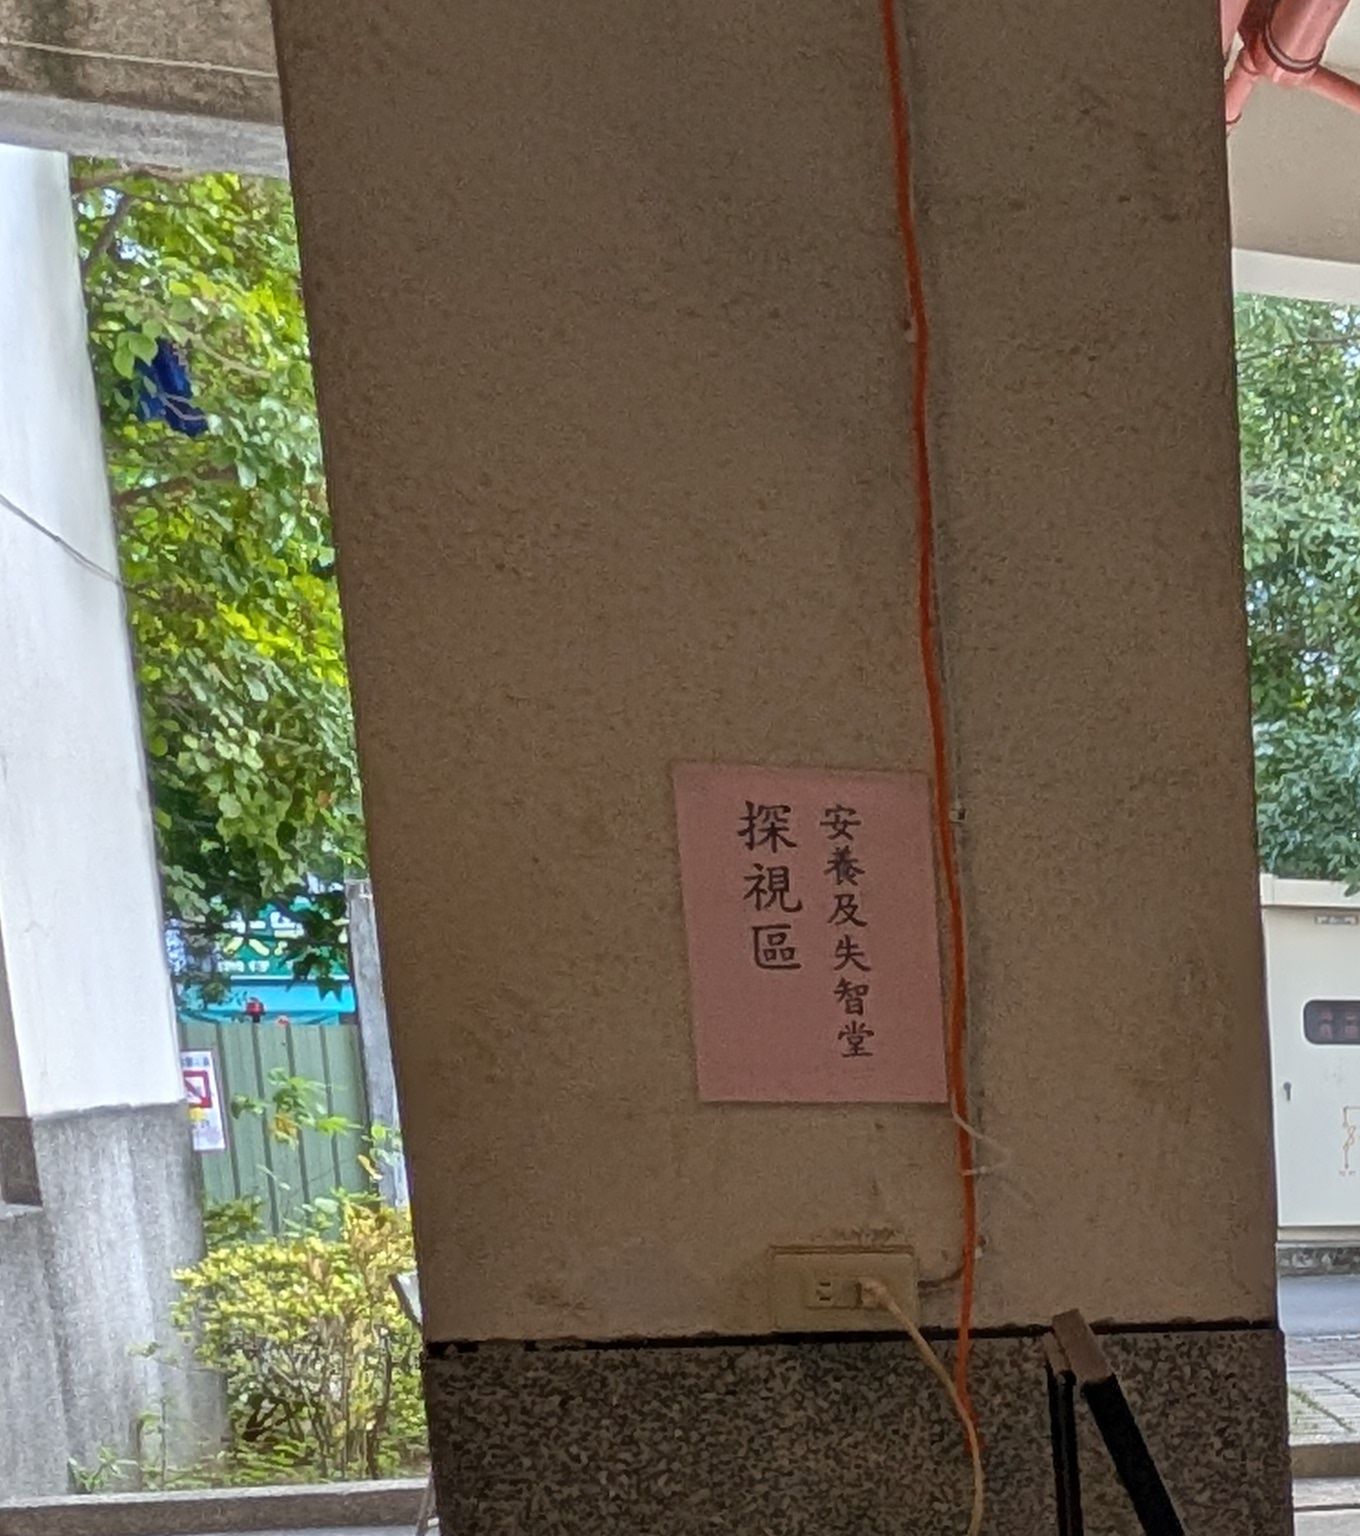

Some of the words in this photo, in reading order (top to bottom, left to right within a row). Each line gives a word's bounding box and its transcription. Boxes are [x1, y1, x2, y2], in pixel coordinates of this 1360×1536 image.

[737, 800, 803, 970] 探視區
[819, 803, 875, 1058] 安養及失智堂
